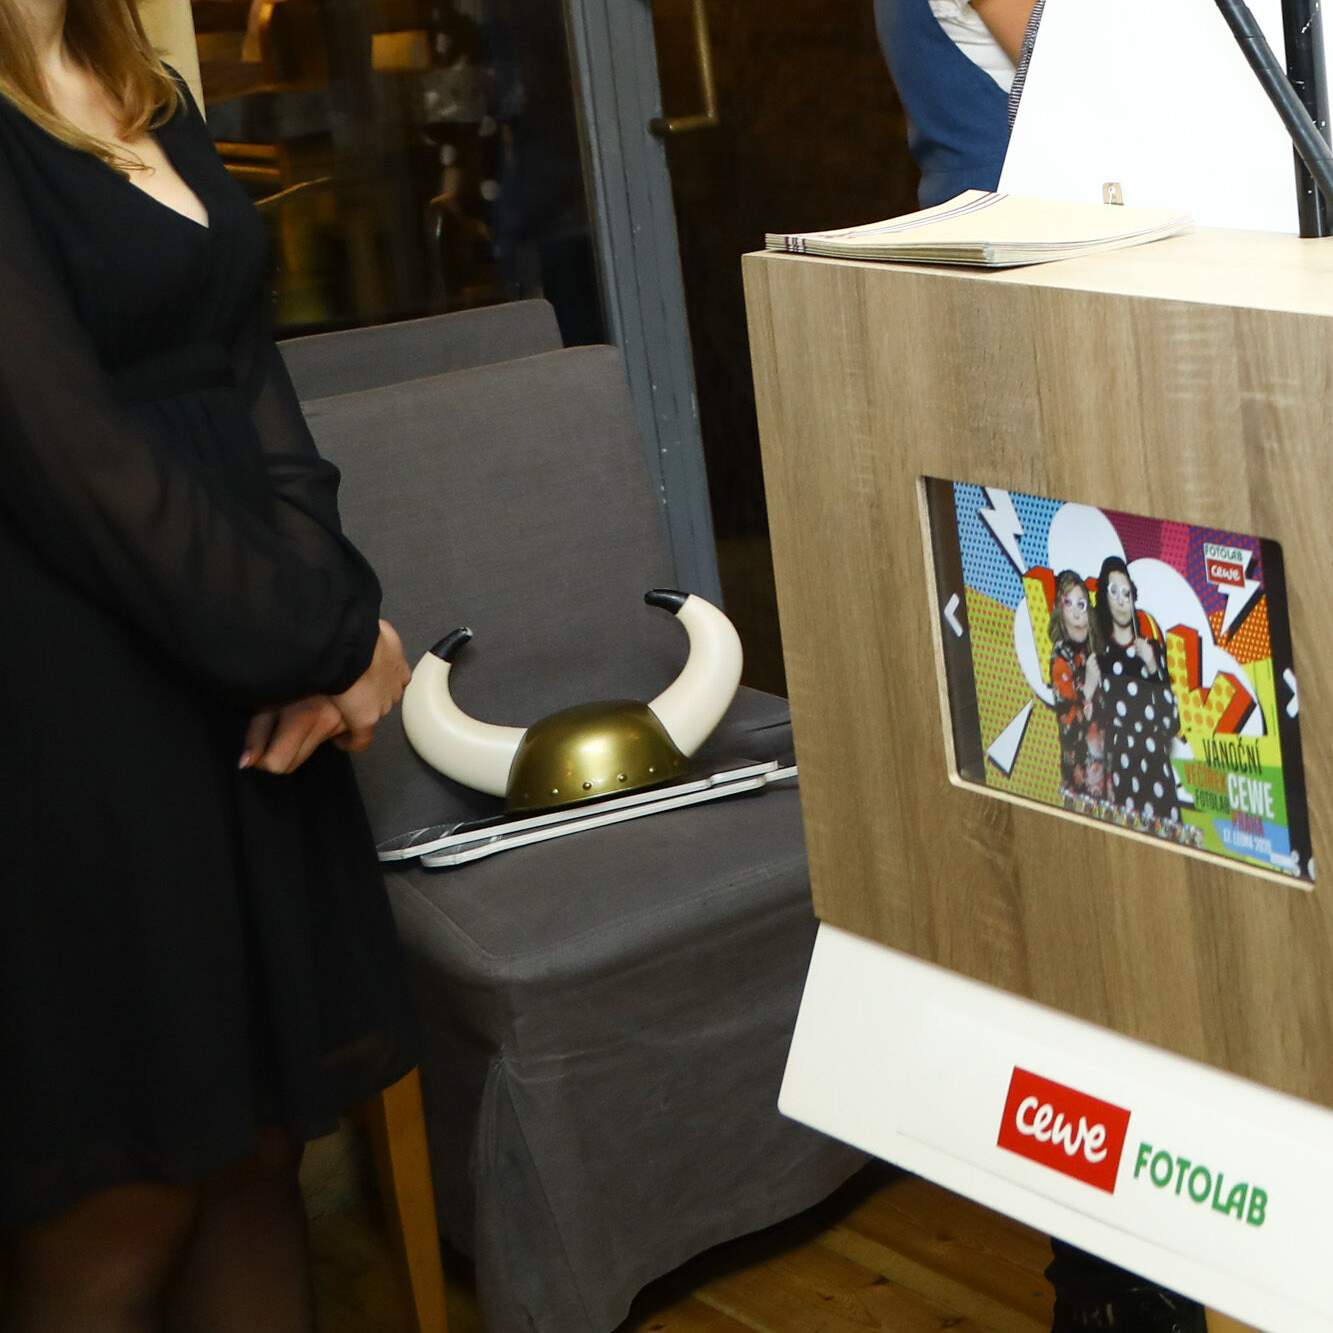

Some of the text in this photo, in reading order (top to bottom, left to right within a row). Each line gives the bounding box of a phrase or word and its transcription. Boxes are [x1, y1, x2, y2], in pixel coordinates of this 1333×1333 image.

[1205, 545, 1243, 562] FOTOLAB
[1211, 564, 1241, 581] cewe
[1228, 772, 1275, 819] CEWE
[1015, 1096, 1268, 1227] cewe FOTOLAB
